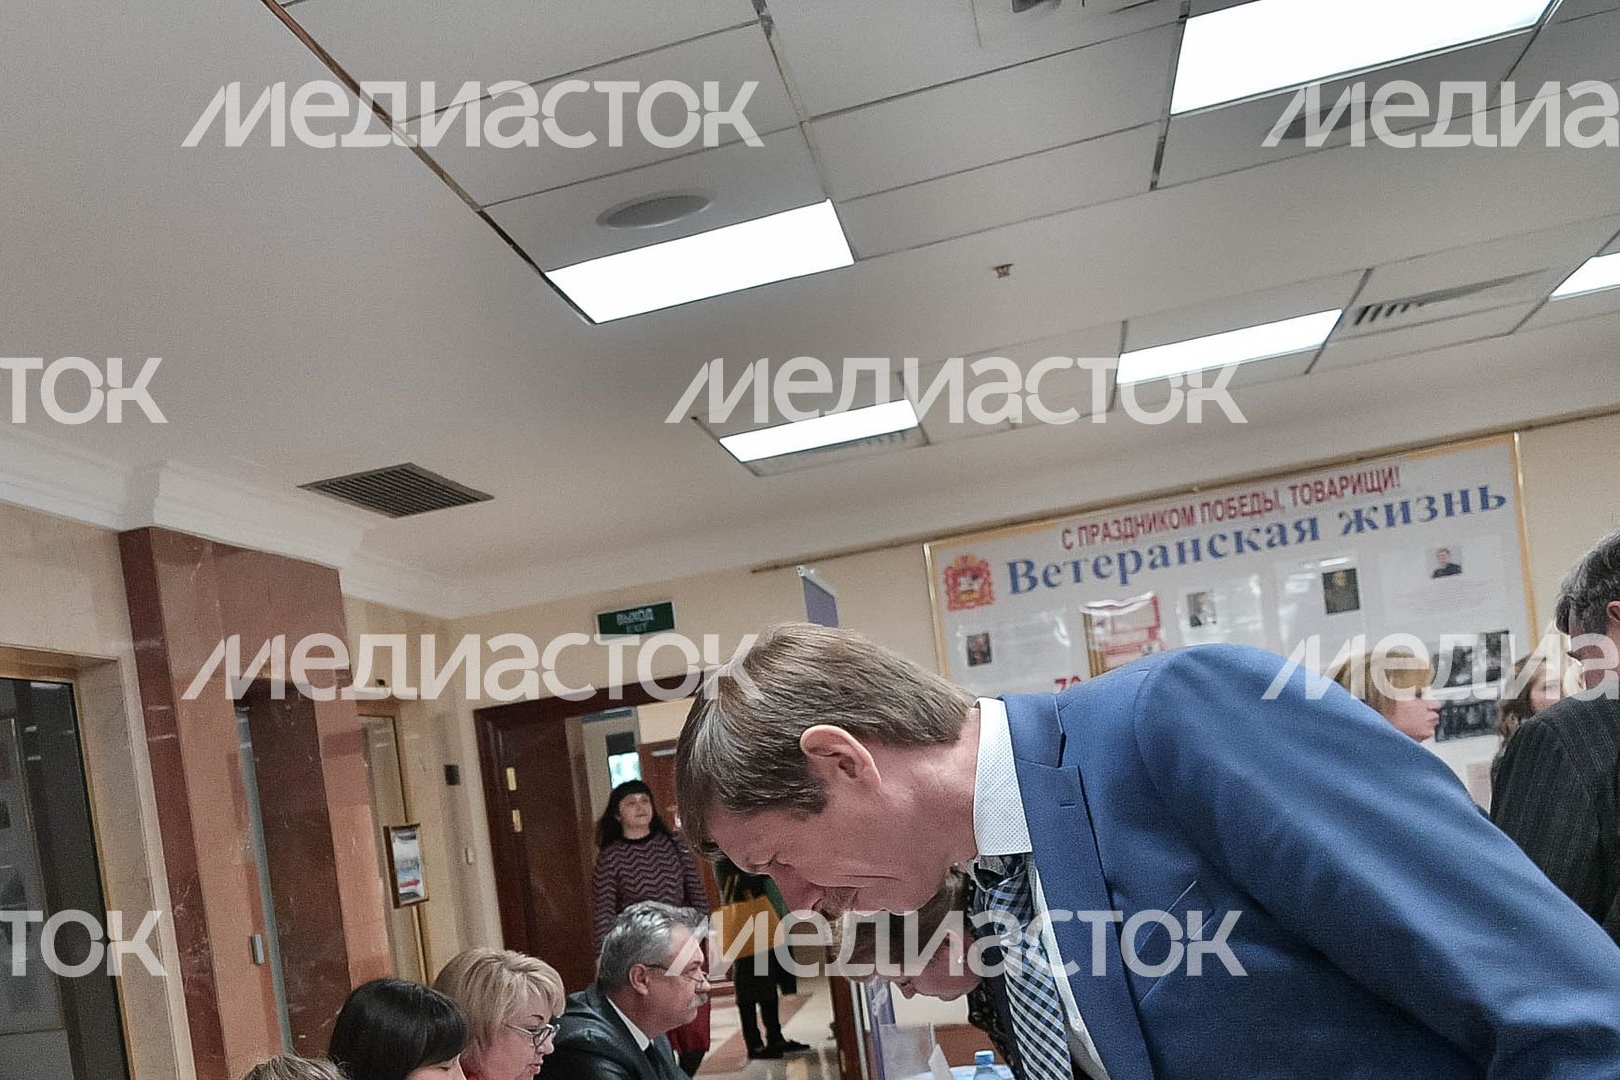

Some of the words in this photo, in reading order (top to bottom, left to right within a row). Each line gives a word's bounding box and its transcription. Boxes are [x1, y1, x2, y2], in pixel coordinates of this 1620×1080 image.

[1007, 513, 1320, 597] Ветеранская
[1338, 485, 1507, 537] жизнь
[1062, 529, 1072, 550] С
[1079, 505, 1196, 547] ПРАЗДНИКОМ
[1288, 466, 1401, 508] ТОВАРИЩИ!
